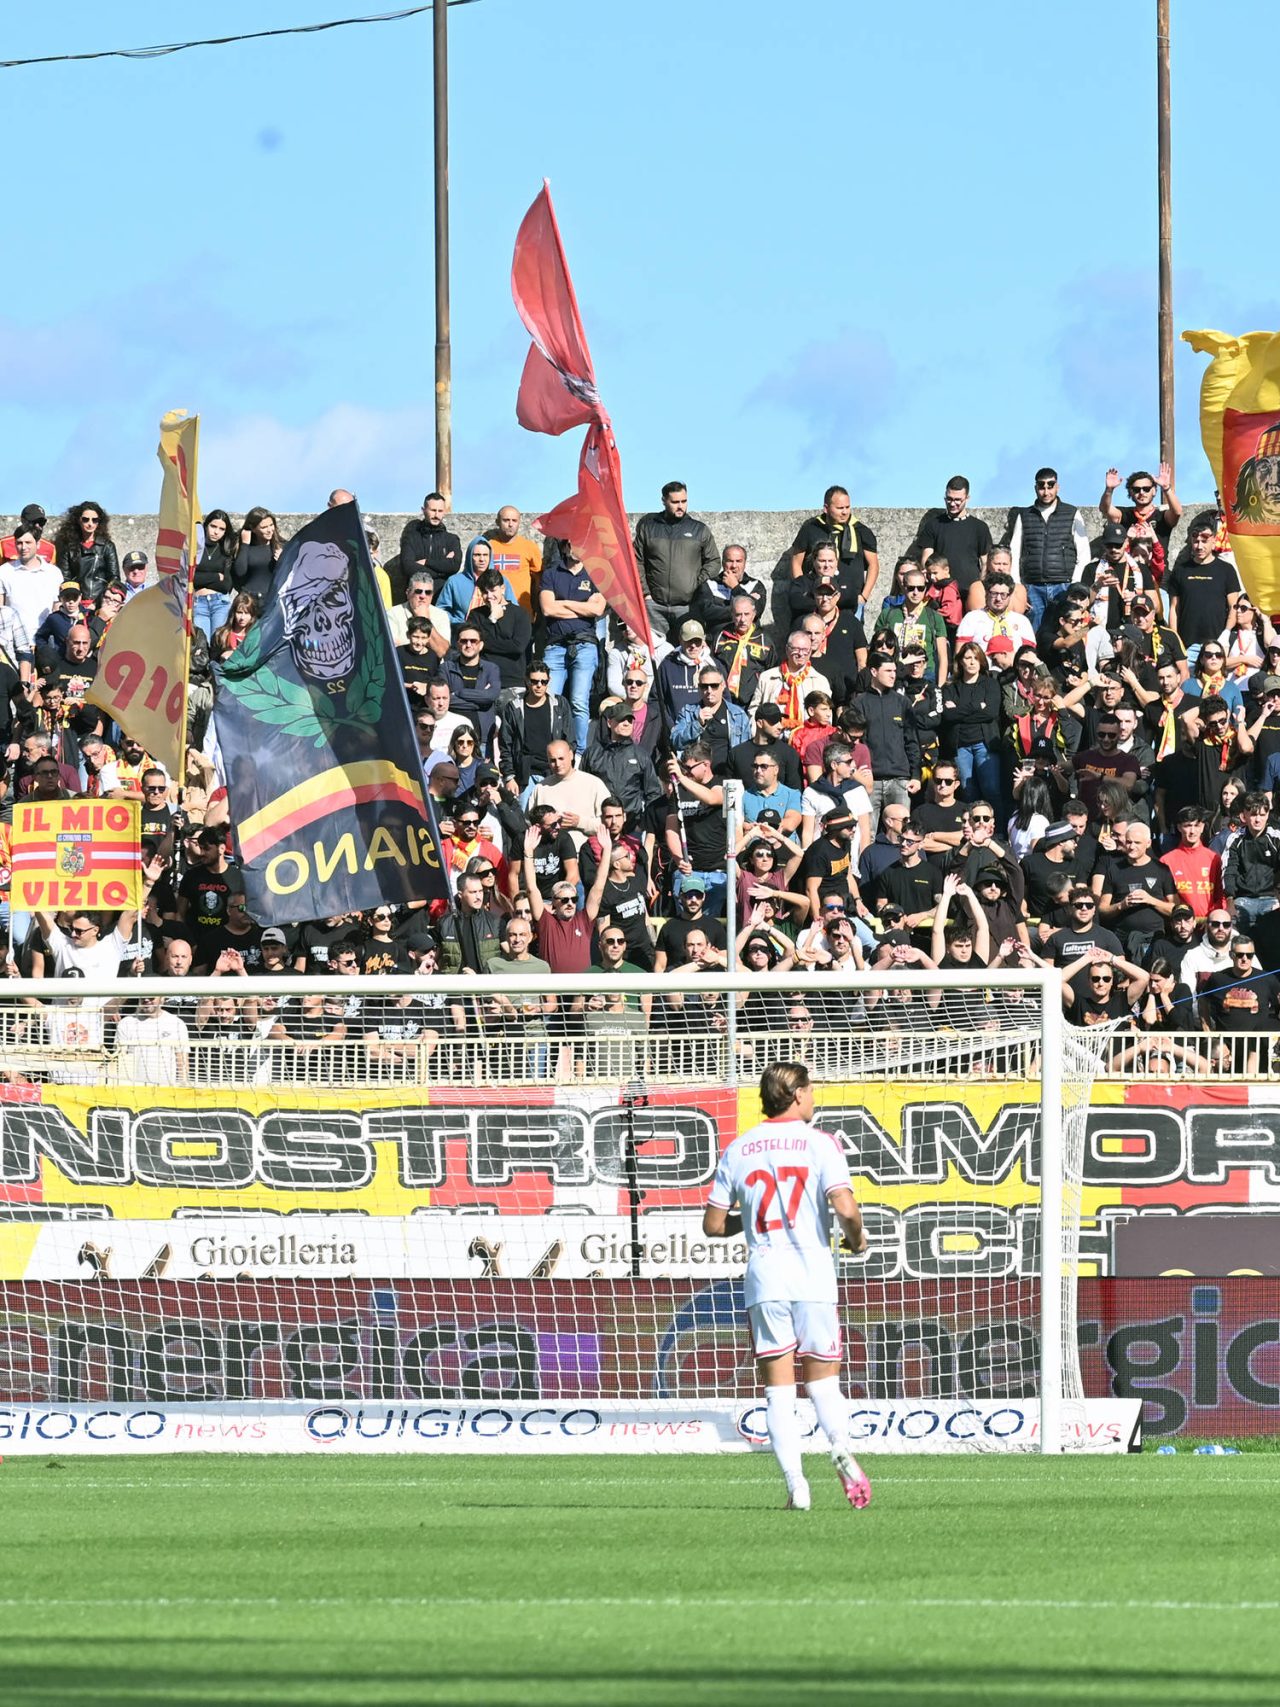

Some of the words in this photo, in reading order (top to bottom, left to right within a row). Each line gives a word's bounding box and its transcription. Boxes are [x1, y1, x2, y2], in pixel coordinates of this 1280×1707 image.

[22, 807, 50, 833] IL
[62, 805, 130, 832] MIO
[22, 880, 129, 907] VIZIO
[0, 1104, 718, 1189] NOSTRO
[741, 1138, 808, 1157] CASTELLINI
[744, 1166, 809, 1235] 27
[189, 1233, 358, 1268] Gioielleria
[174, 1418, 268, 1439] news
[305, 1407, 602, 1441] QUIGIOCO
[609, 1418, 702, 1438] news
[739, 1406, 1025, 1441] QGIOCO
